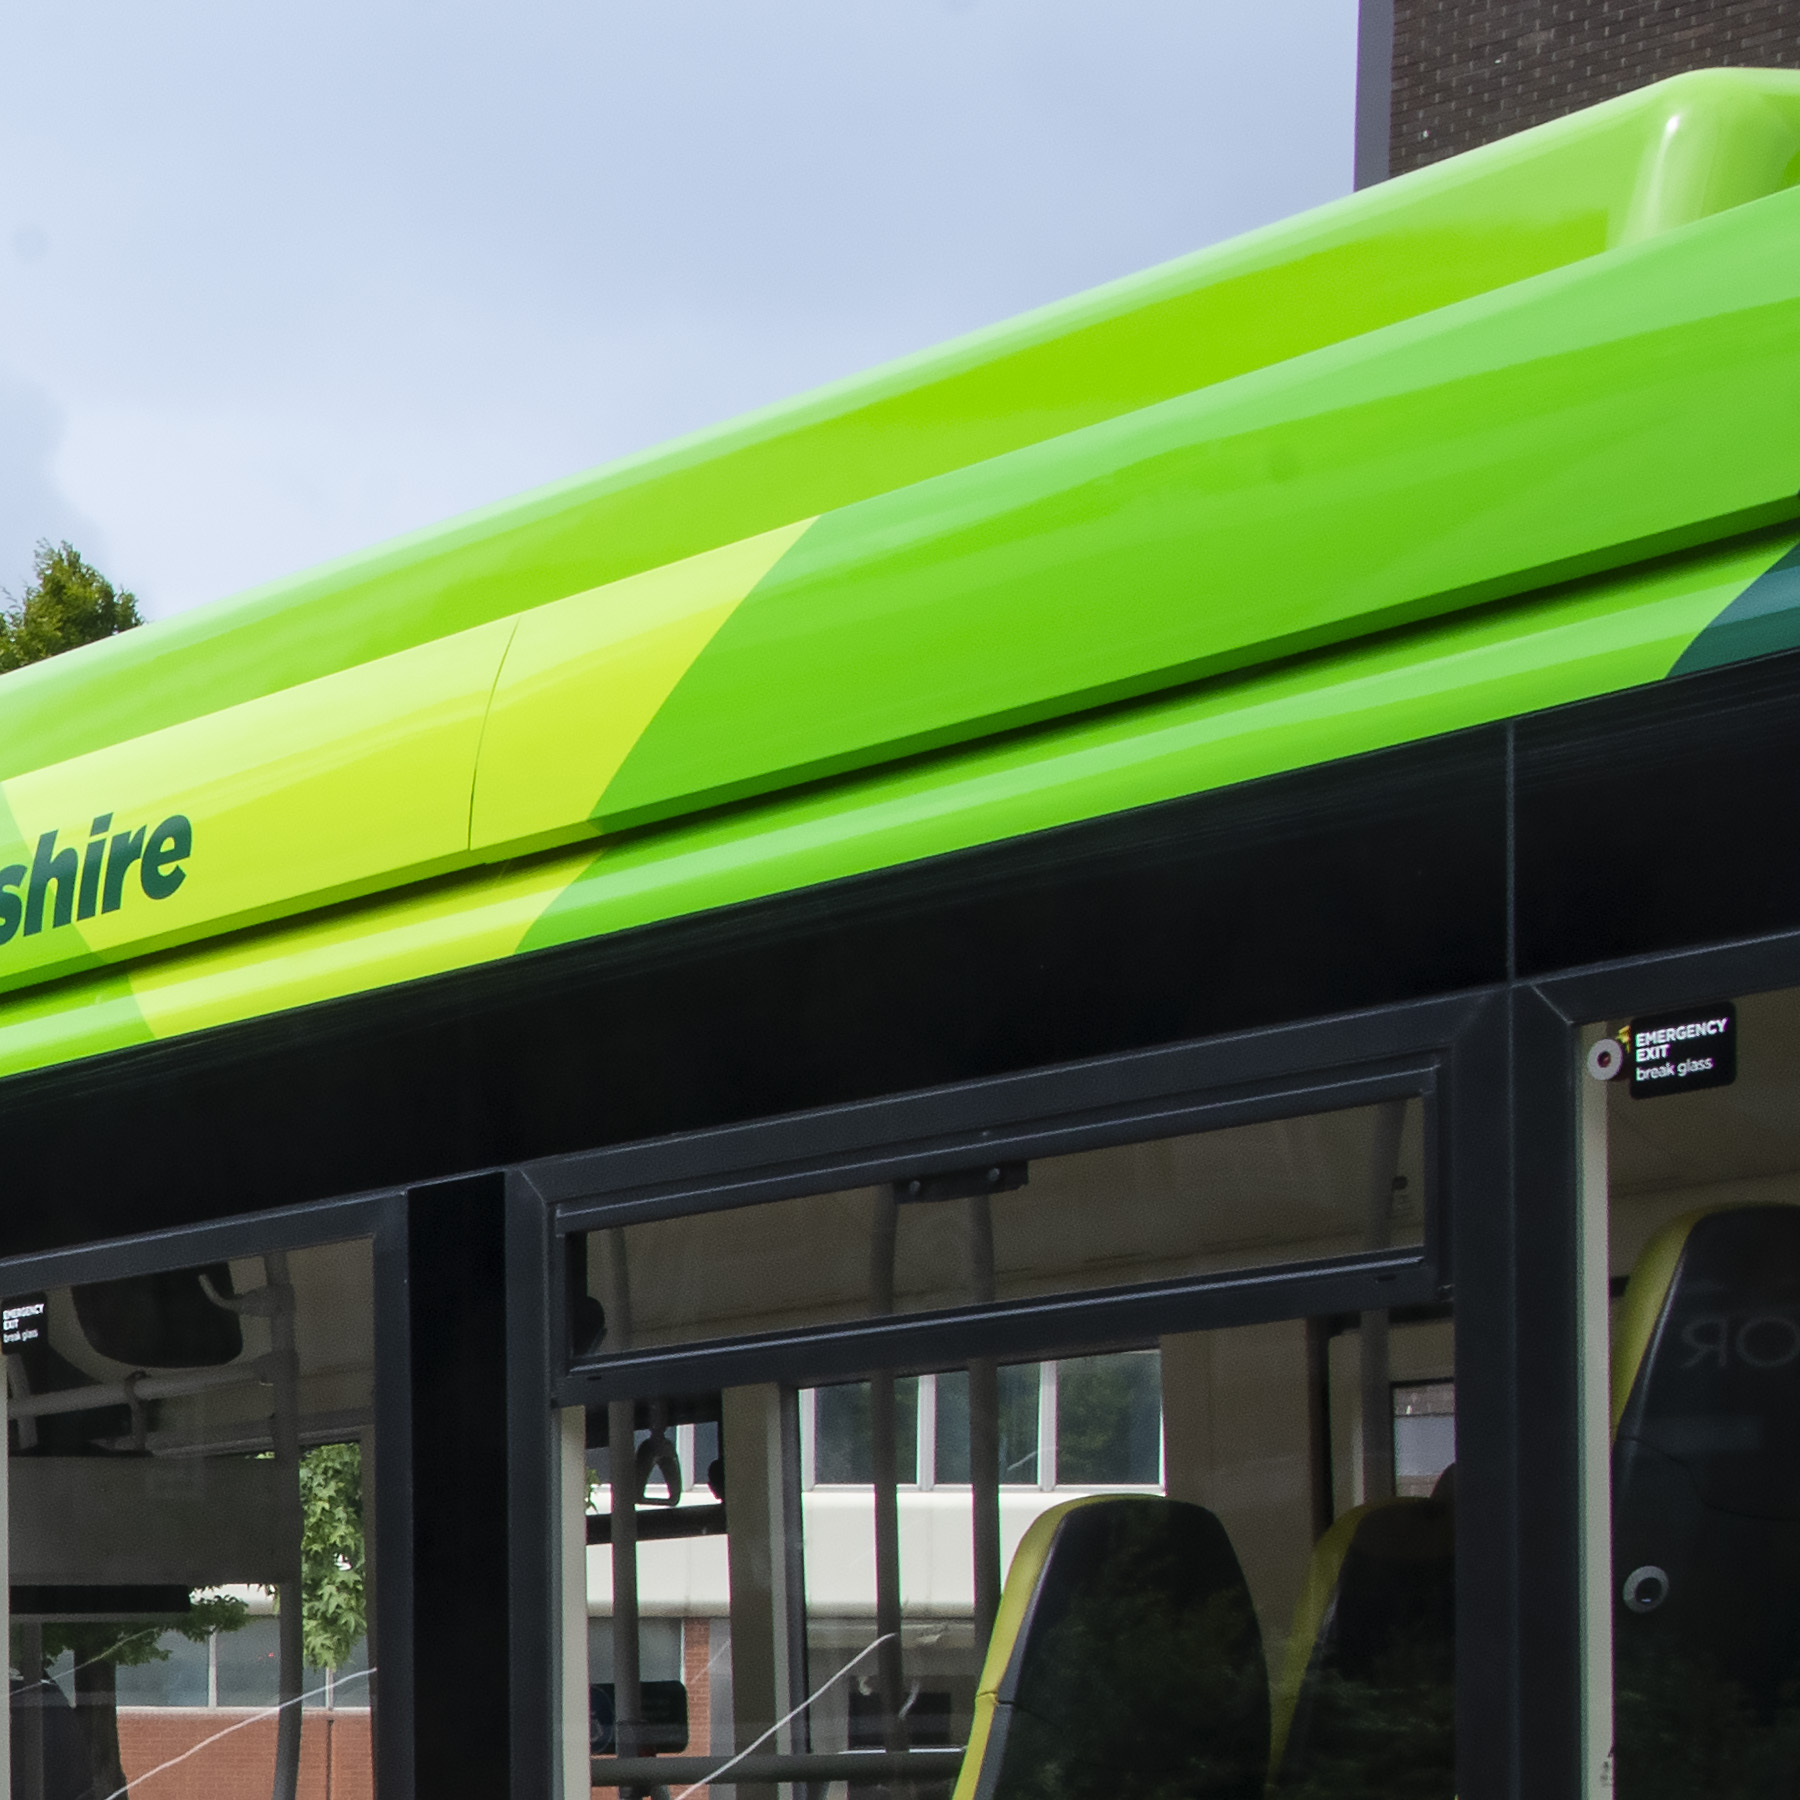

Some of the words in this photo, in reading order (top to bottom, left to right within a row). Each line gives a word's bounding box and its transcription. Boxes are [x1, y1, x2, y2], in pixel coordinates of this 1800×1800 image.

[1635, 1017, 1729, 1047] EMERGENCY
[1635, 1044, 1671, 1063] EXIT
[1635, 1063, 1676, 1082] break
[1676, 1056, 1715, 1078] glass
